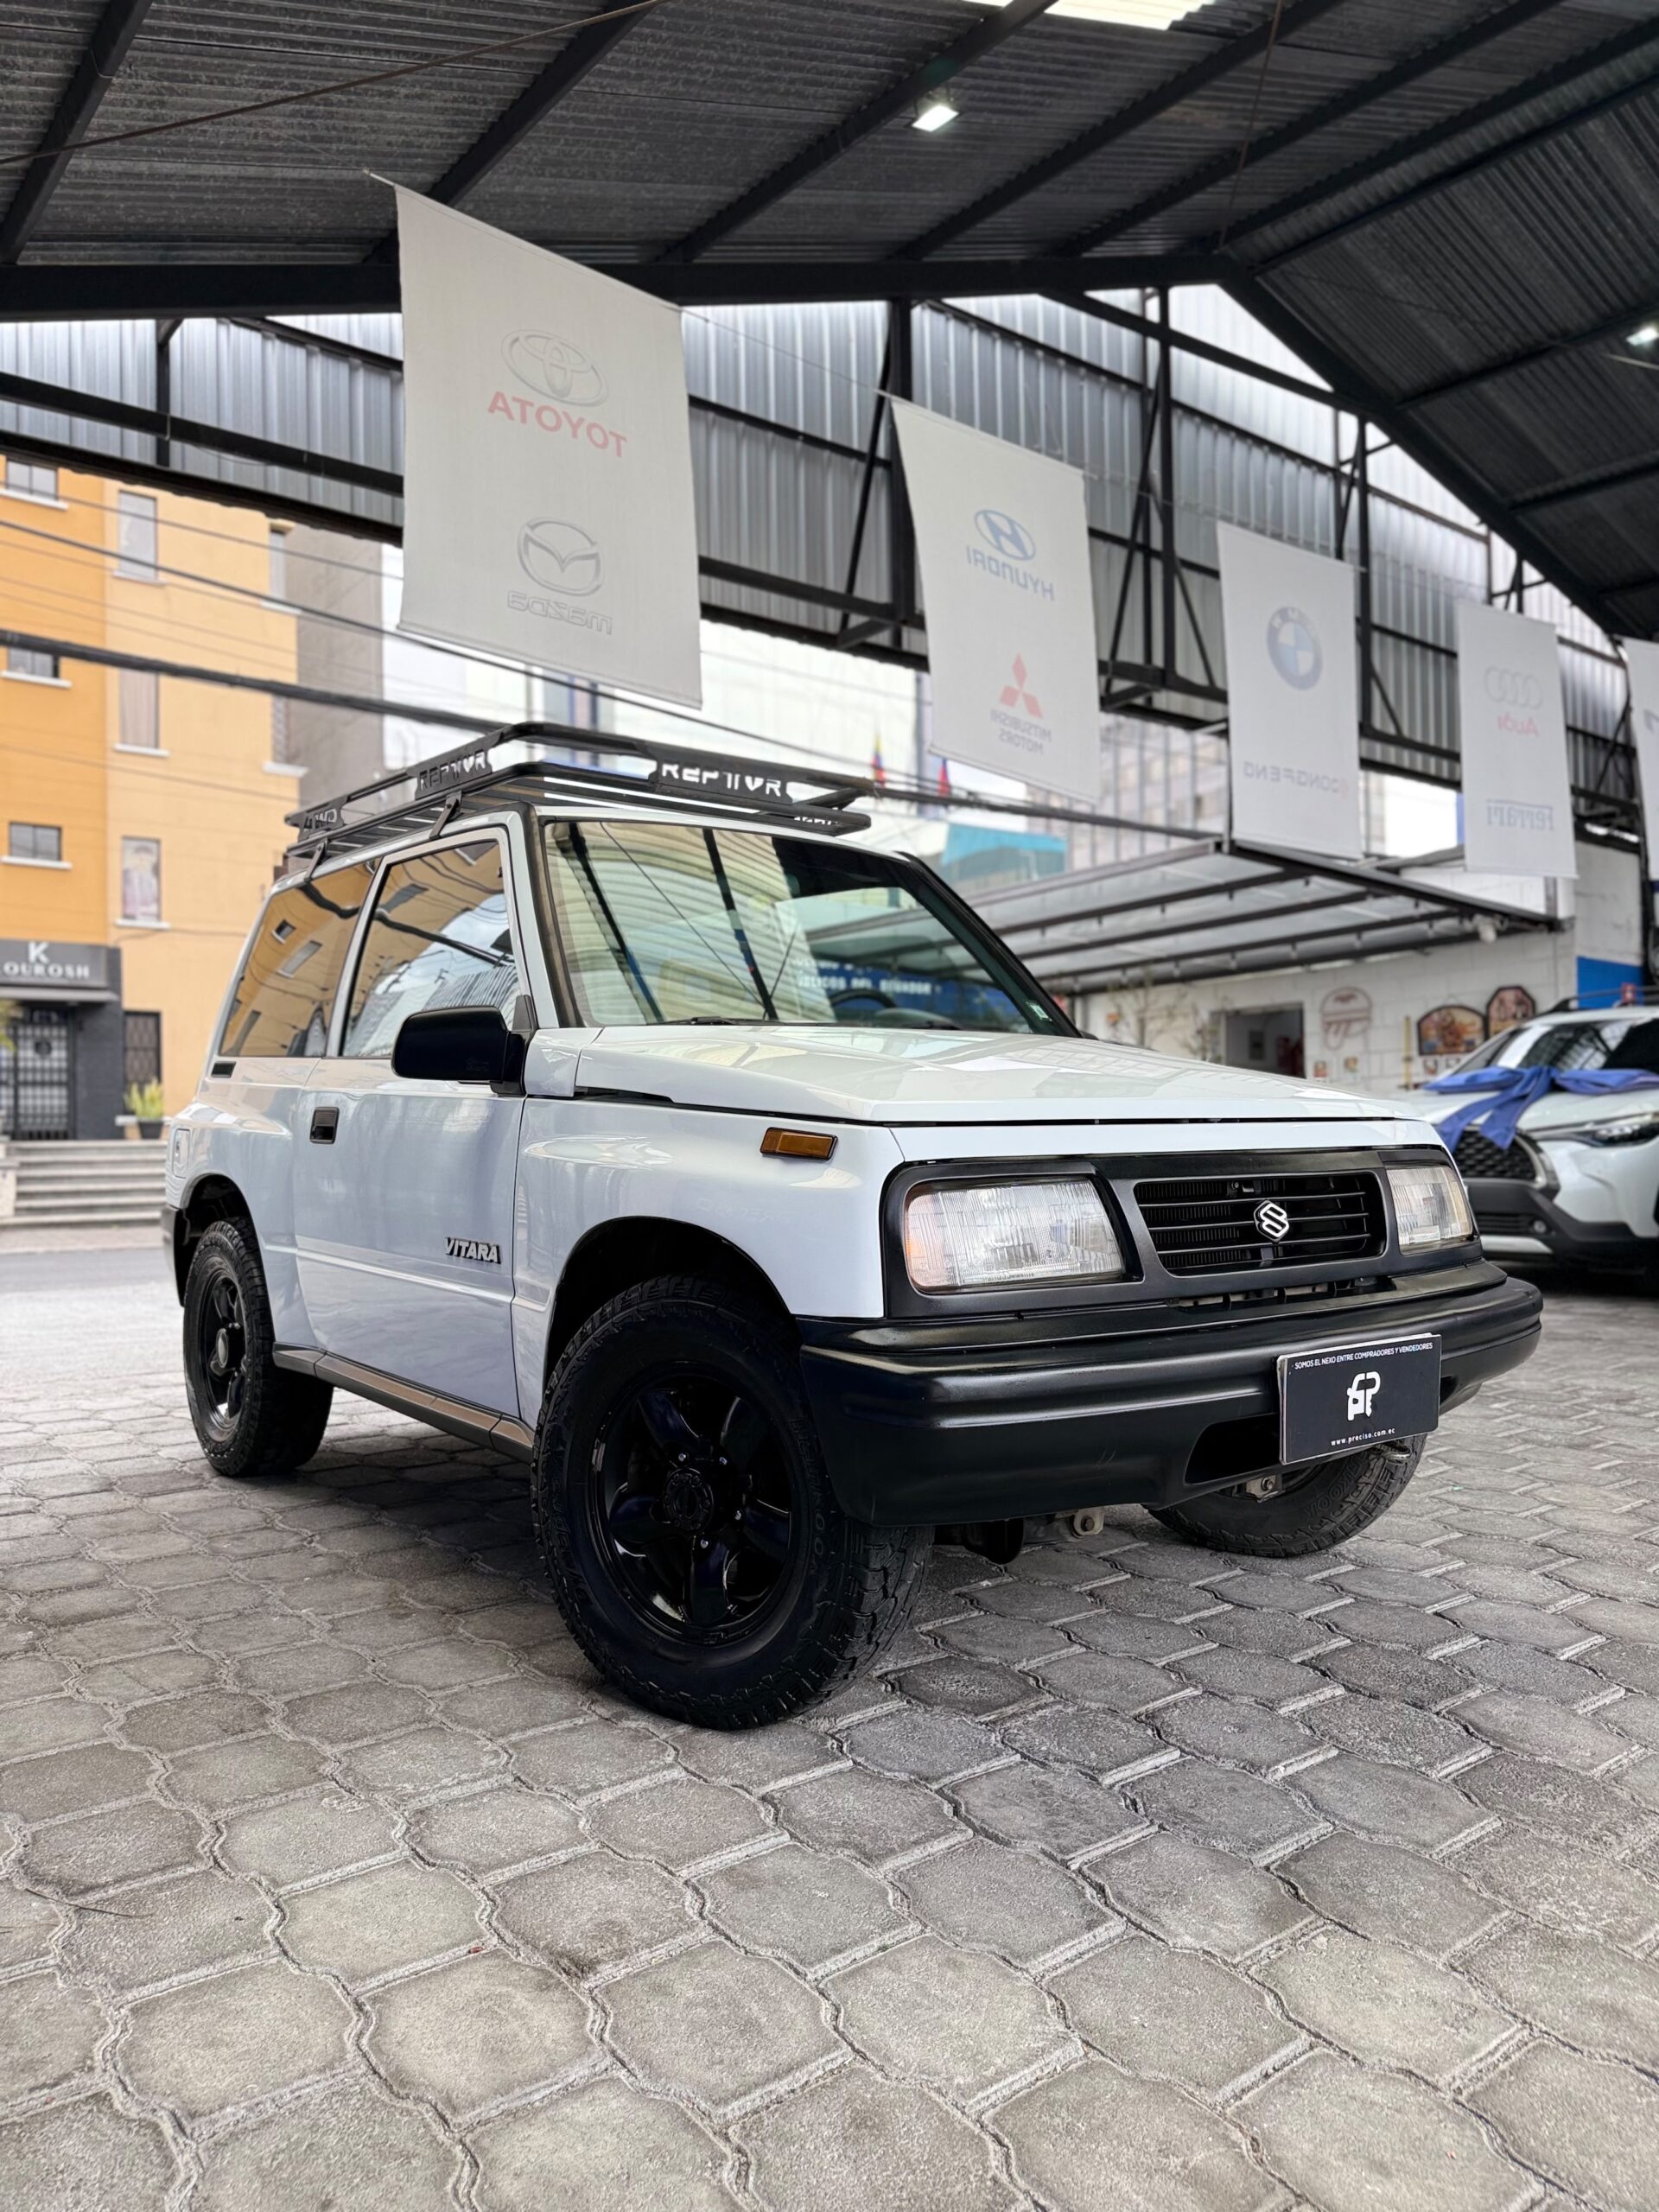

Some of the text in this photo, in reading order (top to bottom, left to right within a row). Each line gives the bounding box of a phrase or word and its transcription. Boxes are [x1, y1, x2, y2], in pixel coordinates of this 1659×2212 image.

[28, 941, 50, 964] K
[445, 1237, 501, 1264] VITARA
[1294, 1359, 1314, 1370] SOMOS
[1321, 1356, 1337, 1365] NEXO
[1336, 1353, 1354, 1363] ENTRE
[1354, 1348, 1395, 1360] COMPRADORES
[1398, 1342, 1433, 1353] VENDEDORES
[1331, 1427, 1395, 1446] www.preciso.com.ec
